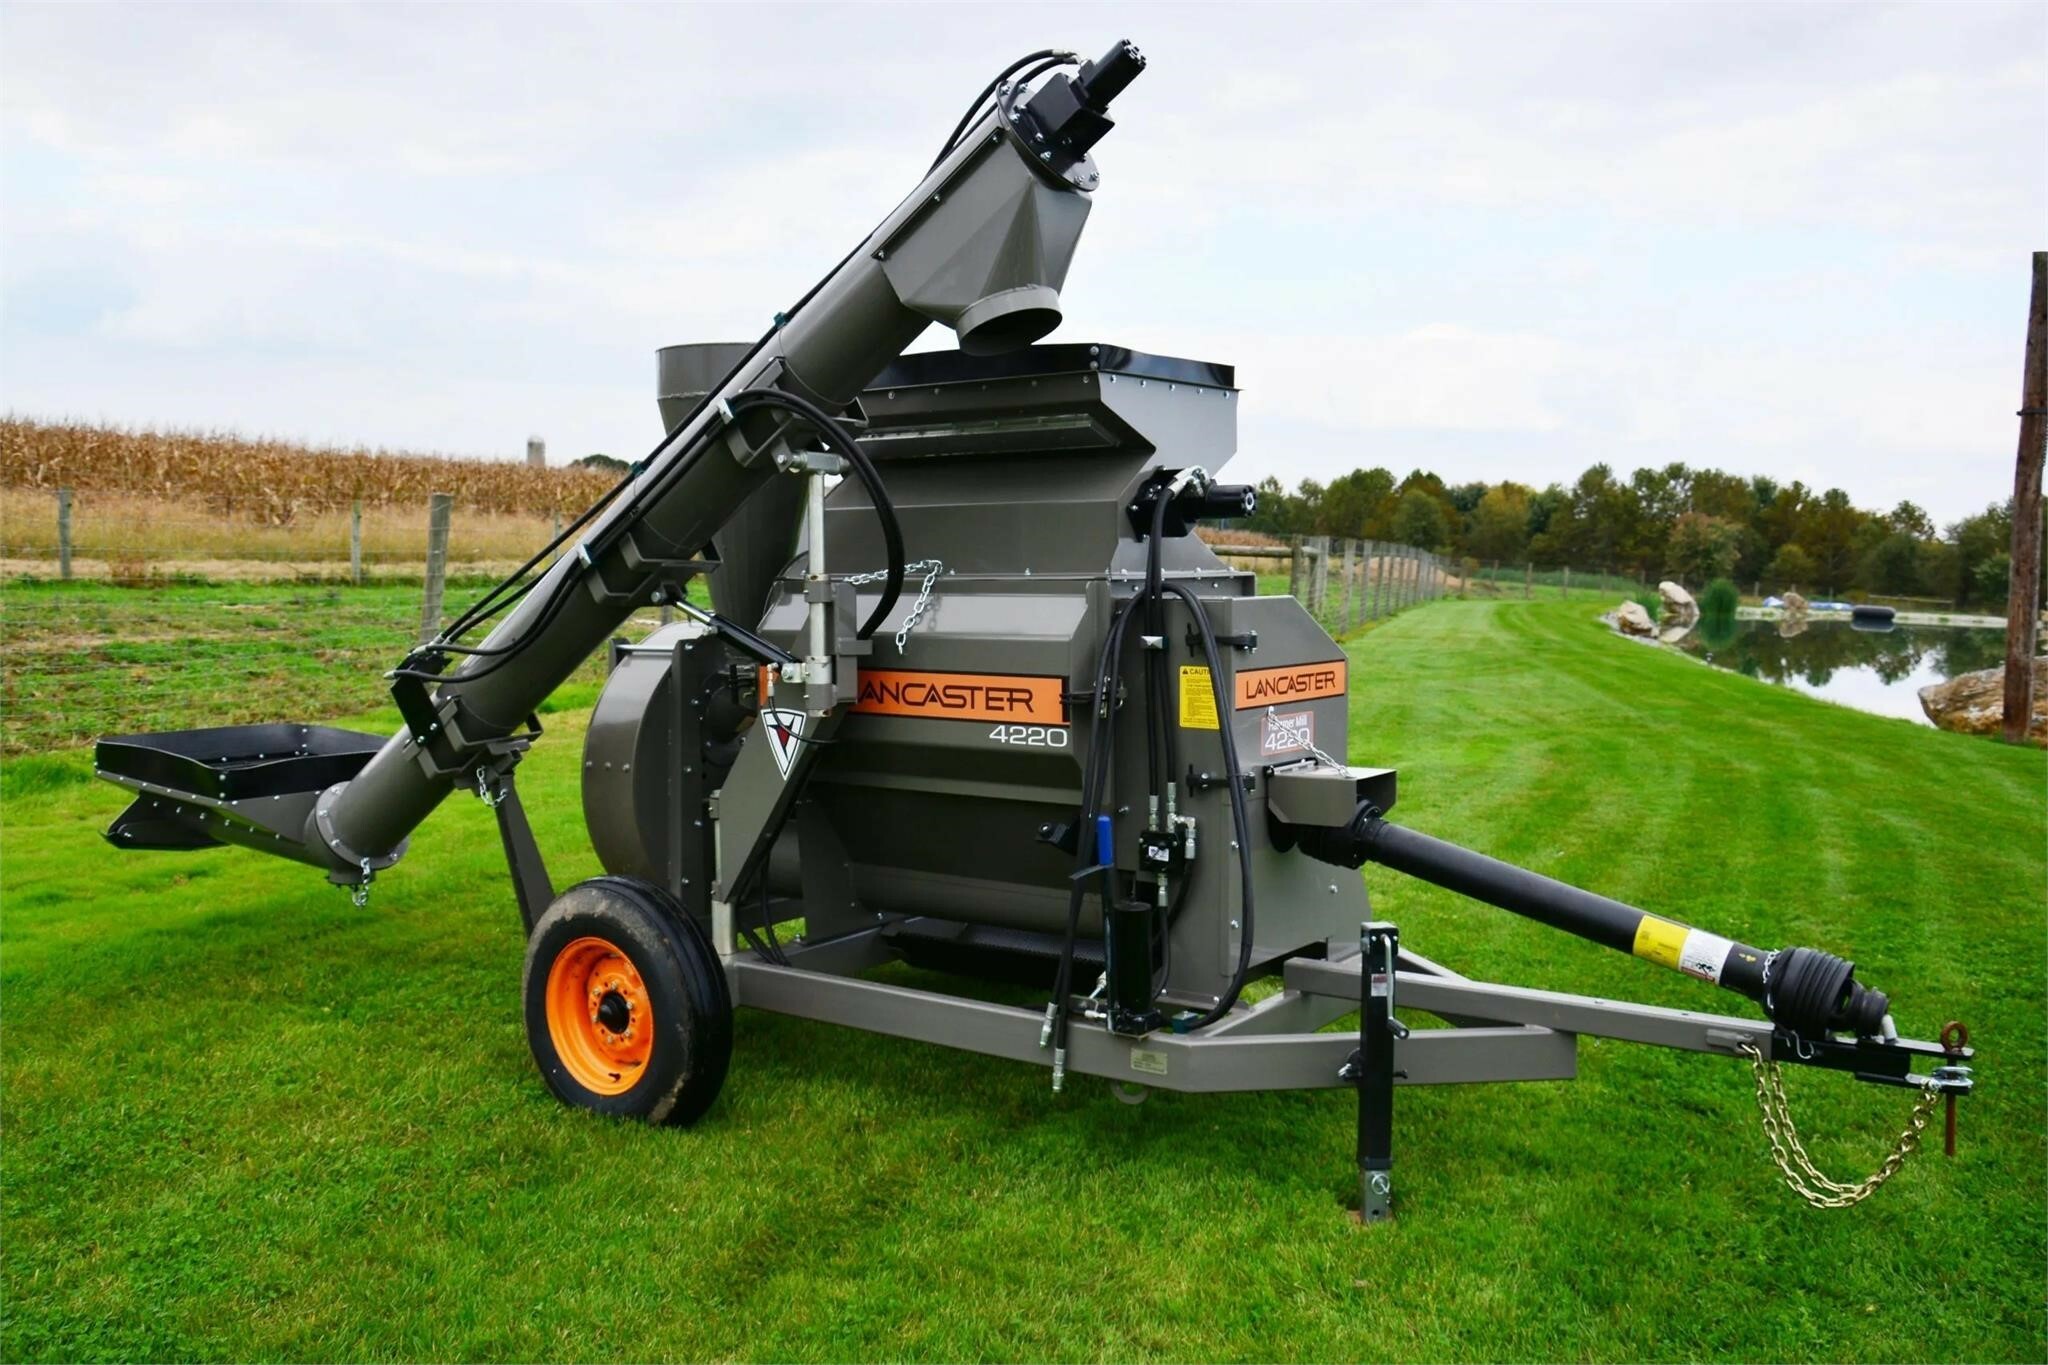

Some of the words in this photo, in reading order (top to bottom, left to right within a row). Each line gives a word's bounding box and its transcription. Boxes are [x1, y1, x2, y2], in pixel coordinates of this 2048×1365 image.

[857, 680, 1034, 713] ANCASTER
[1246, 671, 1336, 699] LANCASTER
[989, 725, 1068, 748] 4220
